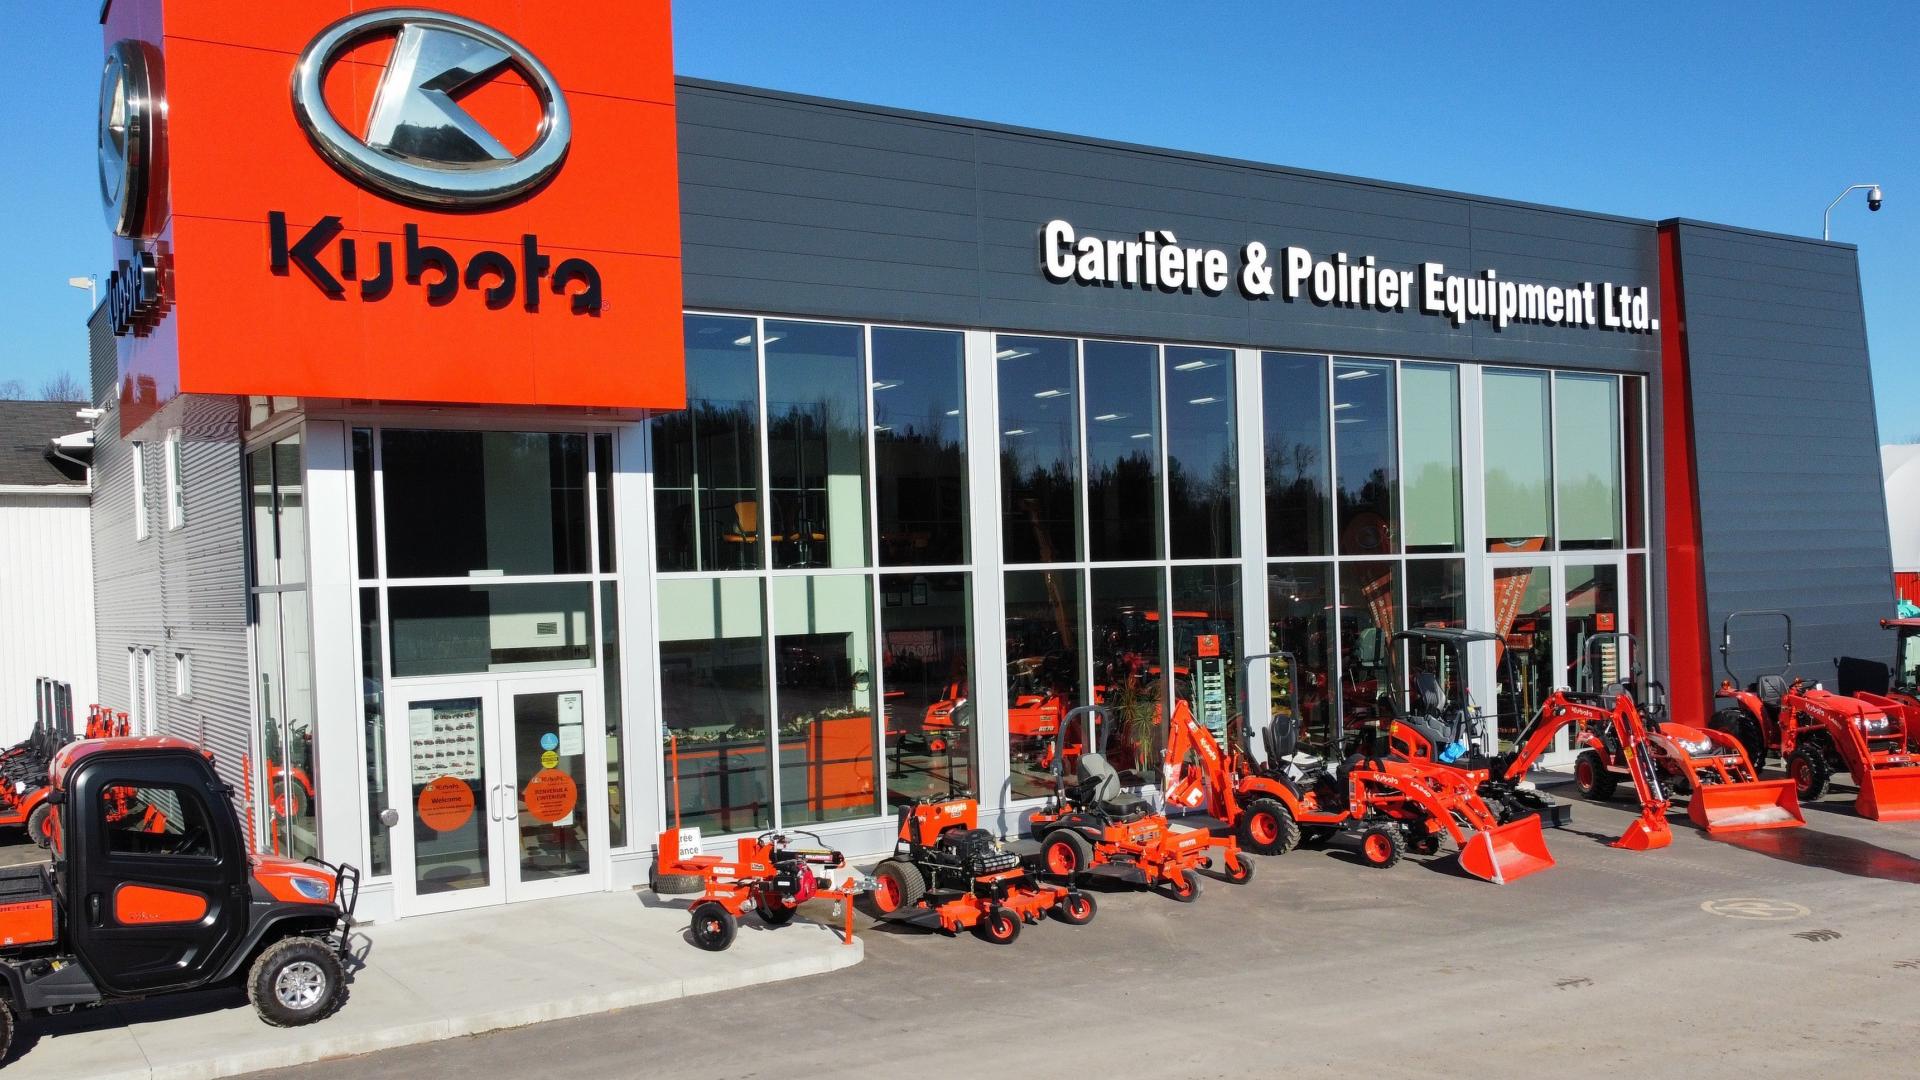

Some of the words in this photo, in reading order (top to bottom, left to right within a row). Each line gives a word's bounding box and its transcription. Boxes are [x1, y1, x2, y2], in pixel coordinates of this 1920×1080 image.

[268, 210, 602, 317] Kubota
[1043, 219, 1228, 294] Carrière
[1241, 241, 1275, 299] &
[1284, 246, 1413, 310] Poirier
[1421, 262, 1597, 330] Equipment
[1600, 282, 1659, 331] Ltd.
[1571, 706, 1593, 718] Kubota
[1373, 773, 1399, 785] Kubota
[679, 846, 699, 856] ance
